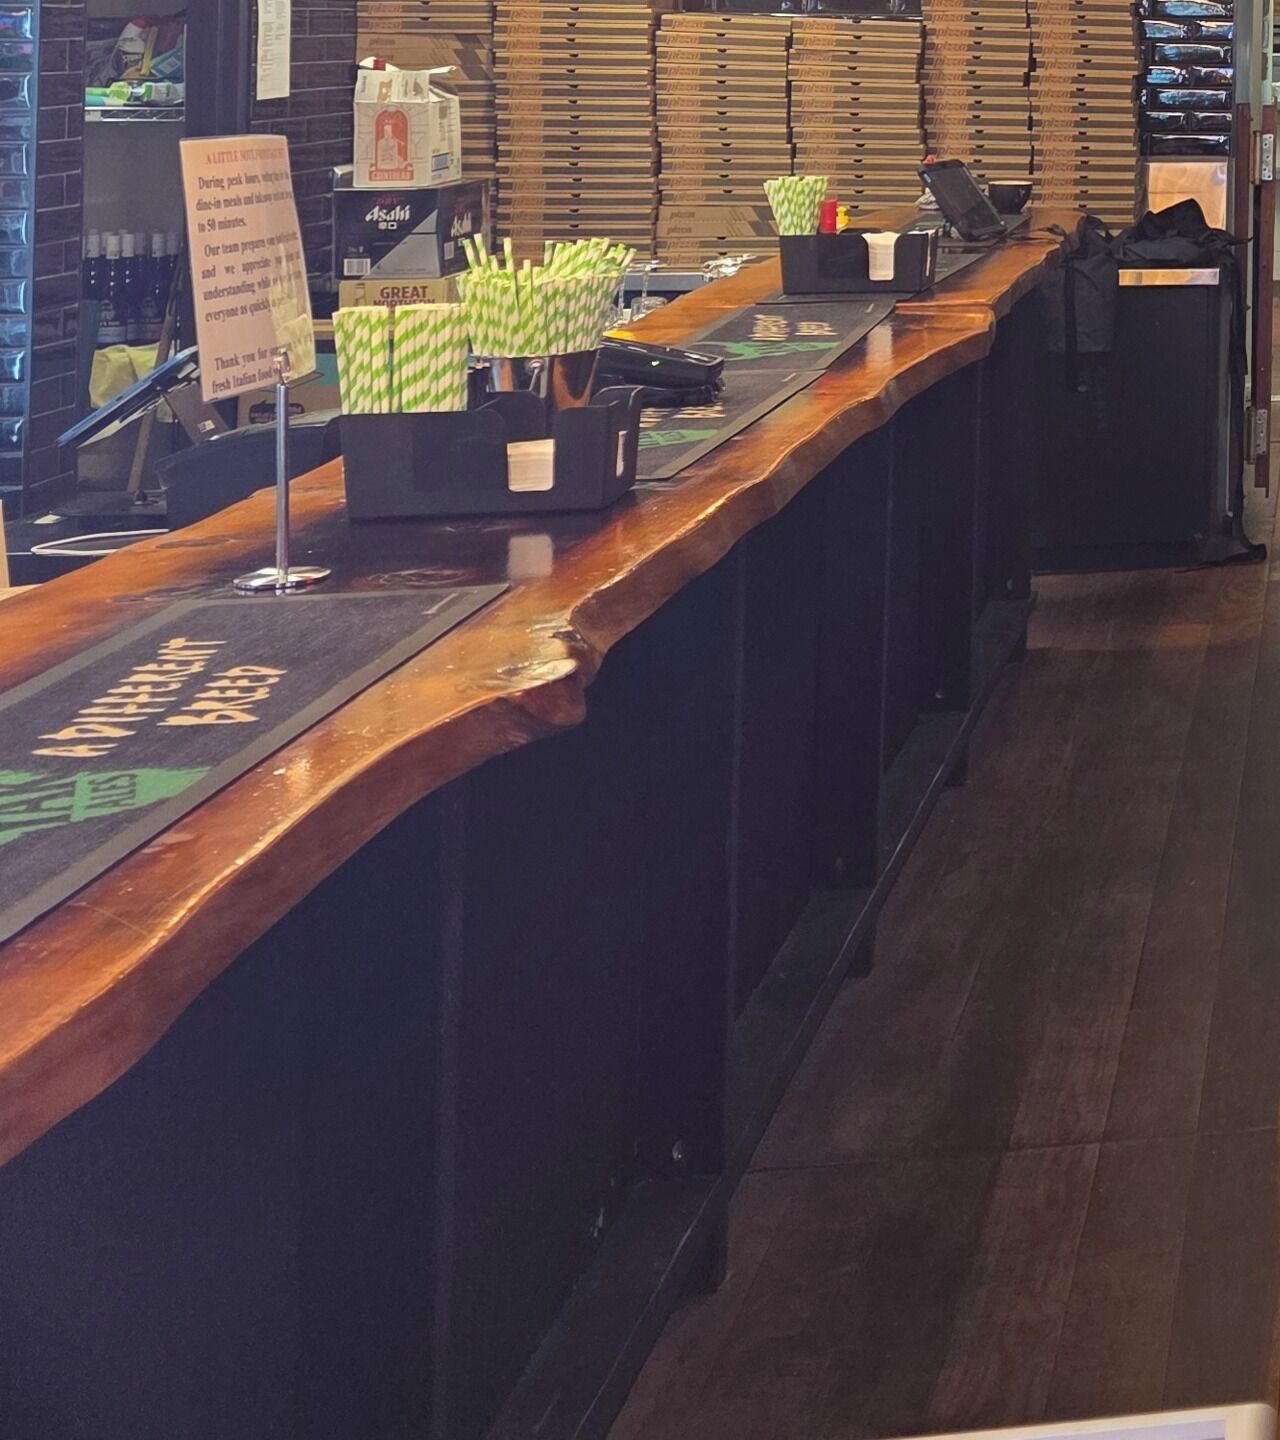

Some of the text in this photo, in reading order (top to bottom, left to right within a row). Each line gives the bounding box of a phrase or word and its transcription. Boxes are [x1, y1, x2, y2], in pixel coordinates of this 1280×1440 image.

[213, 151, 238, 164] LITTLE
[198, 175, 225, 191] During
[227, 173, 242, 190] peak
[195, 195, 222, 211] dine-in
[365, 205, 410, 222] Asahi
[198, 222, 206, 233] to
[204, 244, 221, 257] Our
[222, 242, 239, 255] team
[201, 265, 216, 280] and
[224, 264, 235, 275] we
[203, 280, 256, 302] understanding
[380, 286, 428, 299] GREAT
[205, 305, 239, 323] everyone
[214, 347, 268, 371] Thank you for
[212, 377, 231, 394] fresh
[232, 371, 257, 389] Italian
[258, 366, 273, 382] food
[31, 636, 228, 758] A DIFFERENT
[156, 664, 288, 726] BREED
[84, 770, 137, 809] ALES
